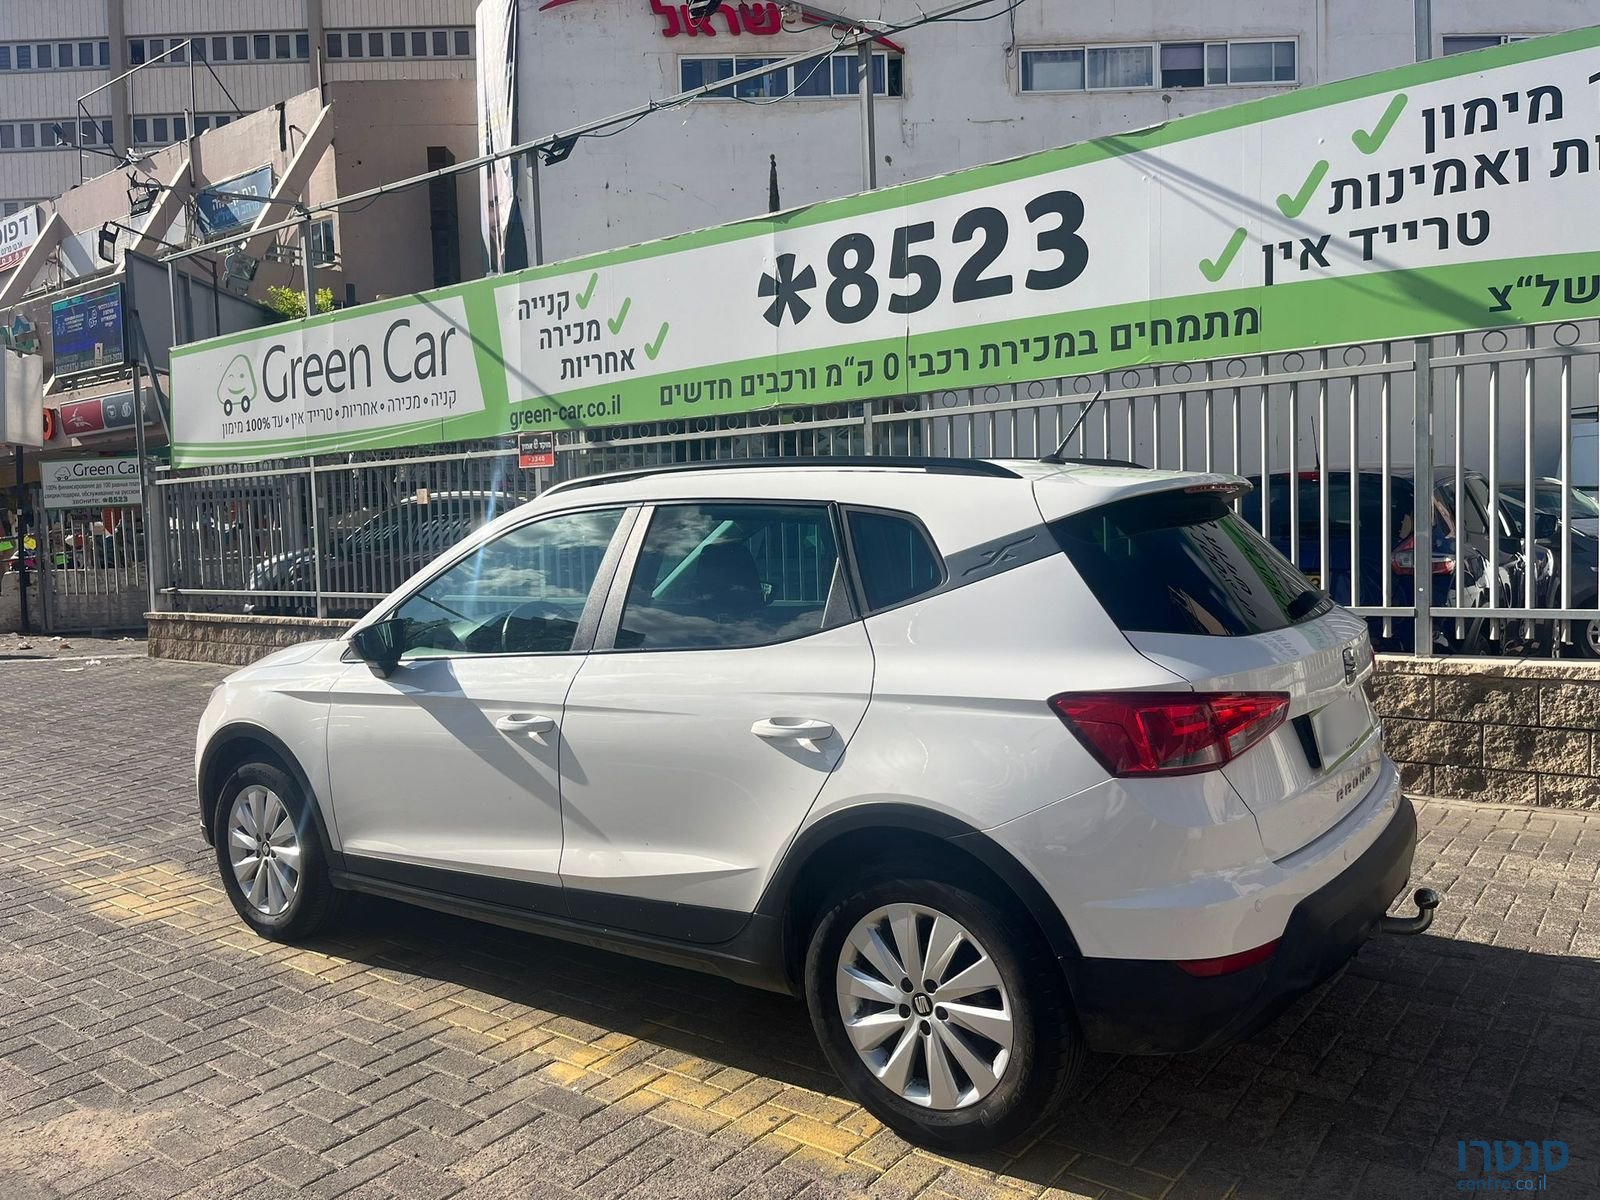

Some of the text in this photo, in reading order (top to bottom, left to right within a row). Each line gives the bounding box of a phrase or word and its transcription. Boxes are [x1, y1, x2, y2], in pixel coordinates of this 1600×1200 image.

[651, 0, 796, 37] שראל
[1422, 85, 1563, 154] מימון
[1328, 146, 1529, 214] ואמינות
[0, 215, 28, 245] דפו
[1262, 209, 1490, 286] טרייד אין
[518, 291, 570, 320] קנייה
[540, 319, 600, 350] מכירה
[1111, 306, 1259, 351] מתמחים
[263, 319, 456, 402] Green Car
[560, 348, 635, 380] אחריות
[883, 352, 900, 380] 0
[907, 348, 969, 378] רכבי
[979, 329, 1098, 369] במכירת
[660, 378, 732, 406] חדשים
[741, 367, 816, 397] ורכבים
[222, 390, 457, 439] קניה מכירה אחריות טרייד אין עד 100% מימון
[510, 394, 621, 430] green-car.co.il
[73, 463, 114, 477] Green
